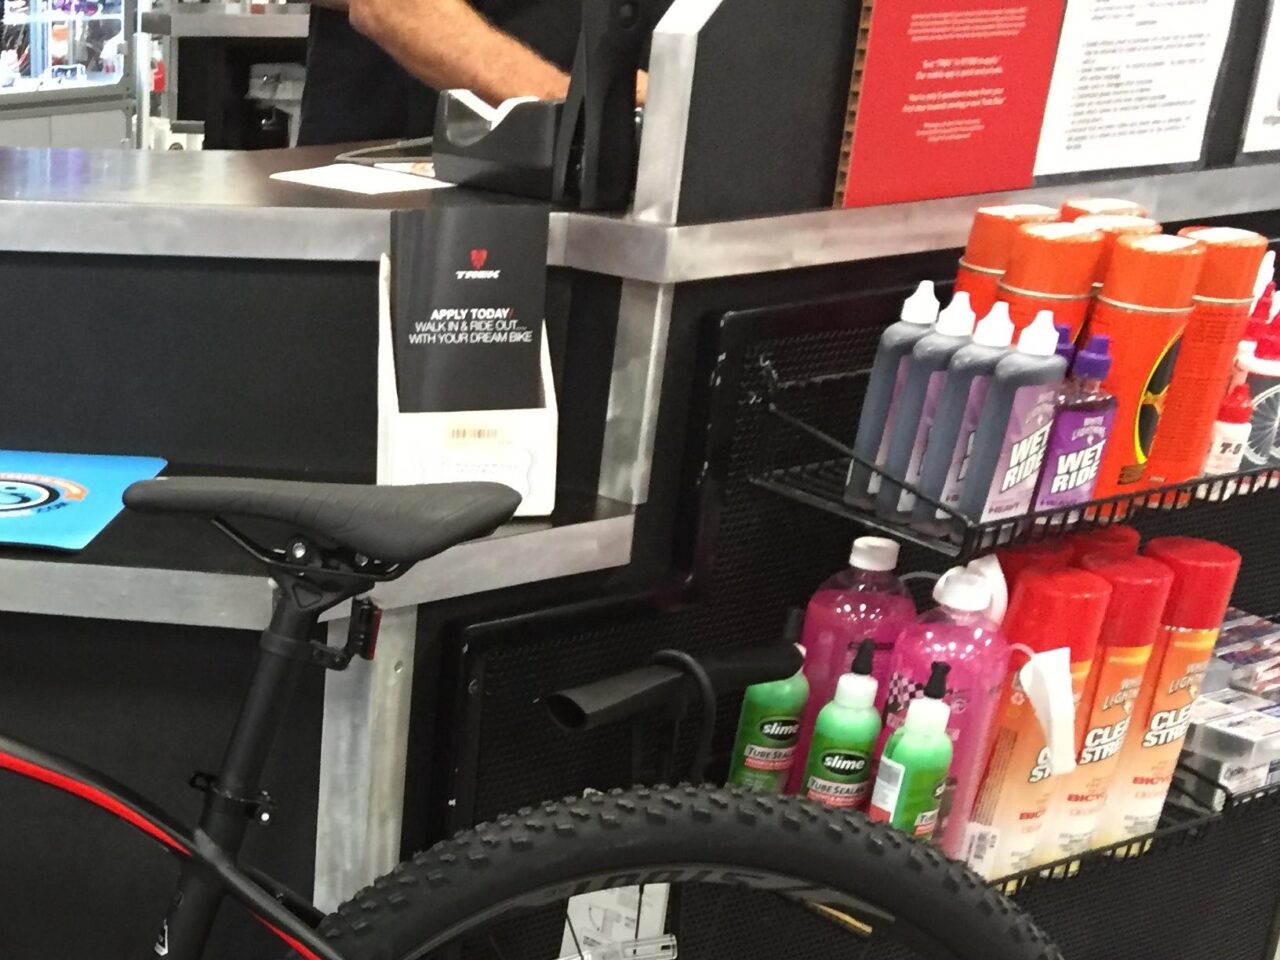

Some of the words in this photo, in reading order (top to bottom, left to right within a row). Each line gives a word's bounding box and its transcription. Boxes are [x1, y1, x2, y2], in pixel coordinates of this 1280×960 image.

[455, 270, 501, 279] TREK
[431, 309, 469, 320] APPLY
[415, 321, 446, 332] WALK
[448, 321, 458, 331] IN
[460, 321, 468, 331] &
[470, 320, 493, 331] RIDE
[409, 333, 436, 344] WITH
[438, 332, 468, 343] YOUR
[470, 331, 508, 343] DREAM
[509, 331, 533, 342] BIKE
[1009, 419, 1054, 469] WET
[1057, 439, 1107, 475] WET
[1001, 449, 1047, 493] RIDE
[1051, 461, 1100, 494] RIDE
[823, 755, 865, 770] slime
